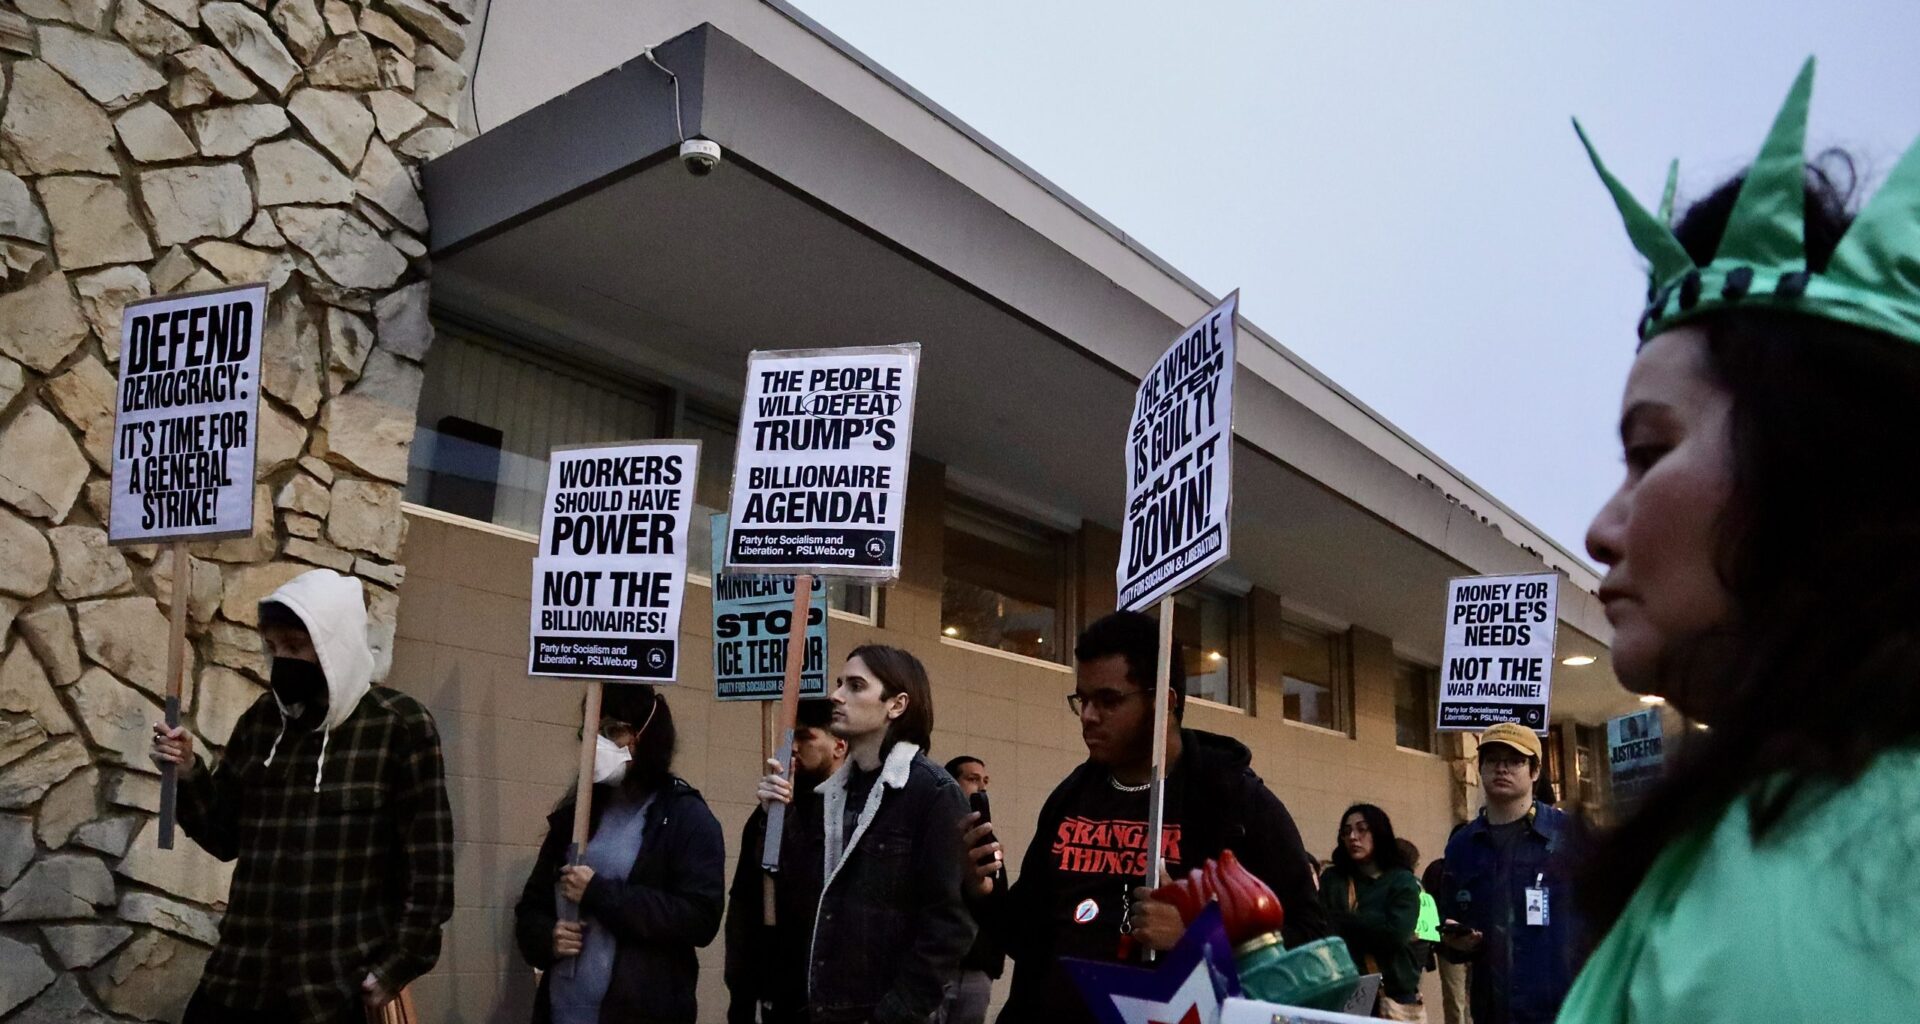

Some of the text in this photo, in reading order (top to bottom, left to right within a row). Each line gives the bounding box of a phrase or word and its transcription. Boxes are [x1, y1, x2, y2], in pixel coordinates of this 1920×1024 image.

[128, 301, 252, 375] DEFEND
[761, 368, 902, 393] THE PEOPLE
[1138, 312, 1222, 420] THE WHOLE
[123, 364, 248, 413] DEMOCRACY:
[1132, 351, 1223, 444] SYSTEM
[759, 394, 899, 417] WILL DEFEAT
[120, 411, 248, 459] IT'S TIME FOR
[753, 418, 896, 450] TRUMP'S
[1134, 375, 1220, 490] IS GUILTY
[129, 449, 232, 494] A GENERAL
[560, 455, 682, 489] WORKERS
[749, 465, 891, 489] BILLIONAIRE
[1129, 431, 1221, 521] SHUT IT
[142, 488, 219, 530] STRIKE!
[554, 489, 680, 513] SHOULD HAVE
[742, 491, 887, 524] AGENDA!
[551, 513, 676, 555] POWER
[1127, 463, 1213, 580] DOWN!
[739, 536, 843, 546] Party for Socialism and
[739, 546, 855, 558] Liberation PSLWeb.org
[1119, 536, 1220, 609] PARTY FOR SOCIALISM & LIBERATION
[542, 571, 672, 608] NOT THE
[1456, 583, 1548, 602] MONEY FOR
[542, 610, 666, 633] BILLIONAIRES!
[716, 608, 823, 638] STOP
[1454, 602, 1547, 624] PEOPLE'S
[540, 644, 627, 655] Party for Socialism and
[1464, 625, 1531, 646] NEEDS
[540, 655, 638, 669] Liberation PSLWeb.org
[718, 641, 743, 675] ICE
[1449, 657, 1542, 681] NOT THE
[719, 682, 734, 693] PARTY
[735, 682, 746, 692] FOR
[746, 681, 777, 691] SOCIALISM
[778, 681, 785, 690] &
[1447, 683, 1541, 697] WAR MACHINE!
[1480, 715, 1520, 723] PSLWeb.org
[1611, 740, 1642, 764] JUSTICE
[1059, 847, 1147, 876] THINGS
